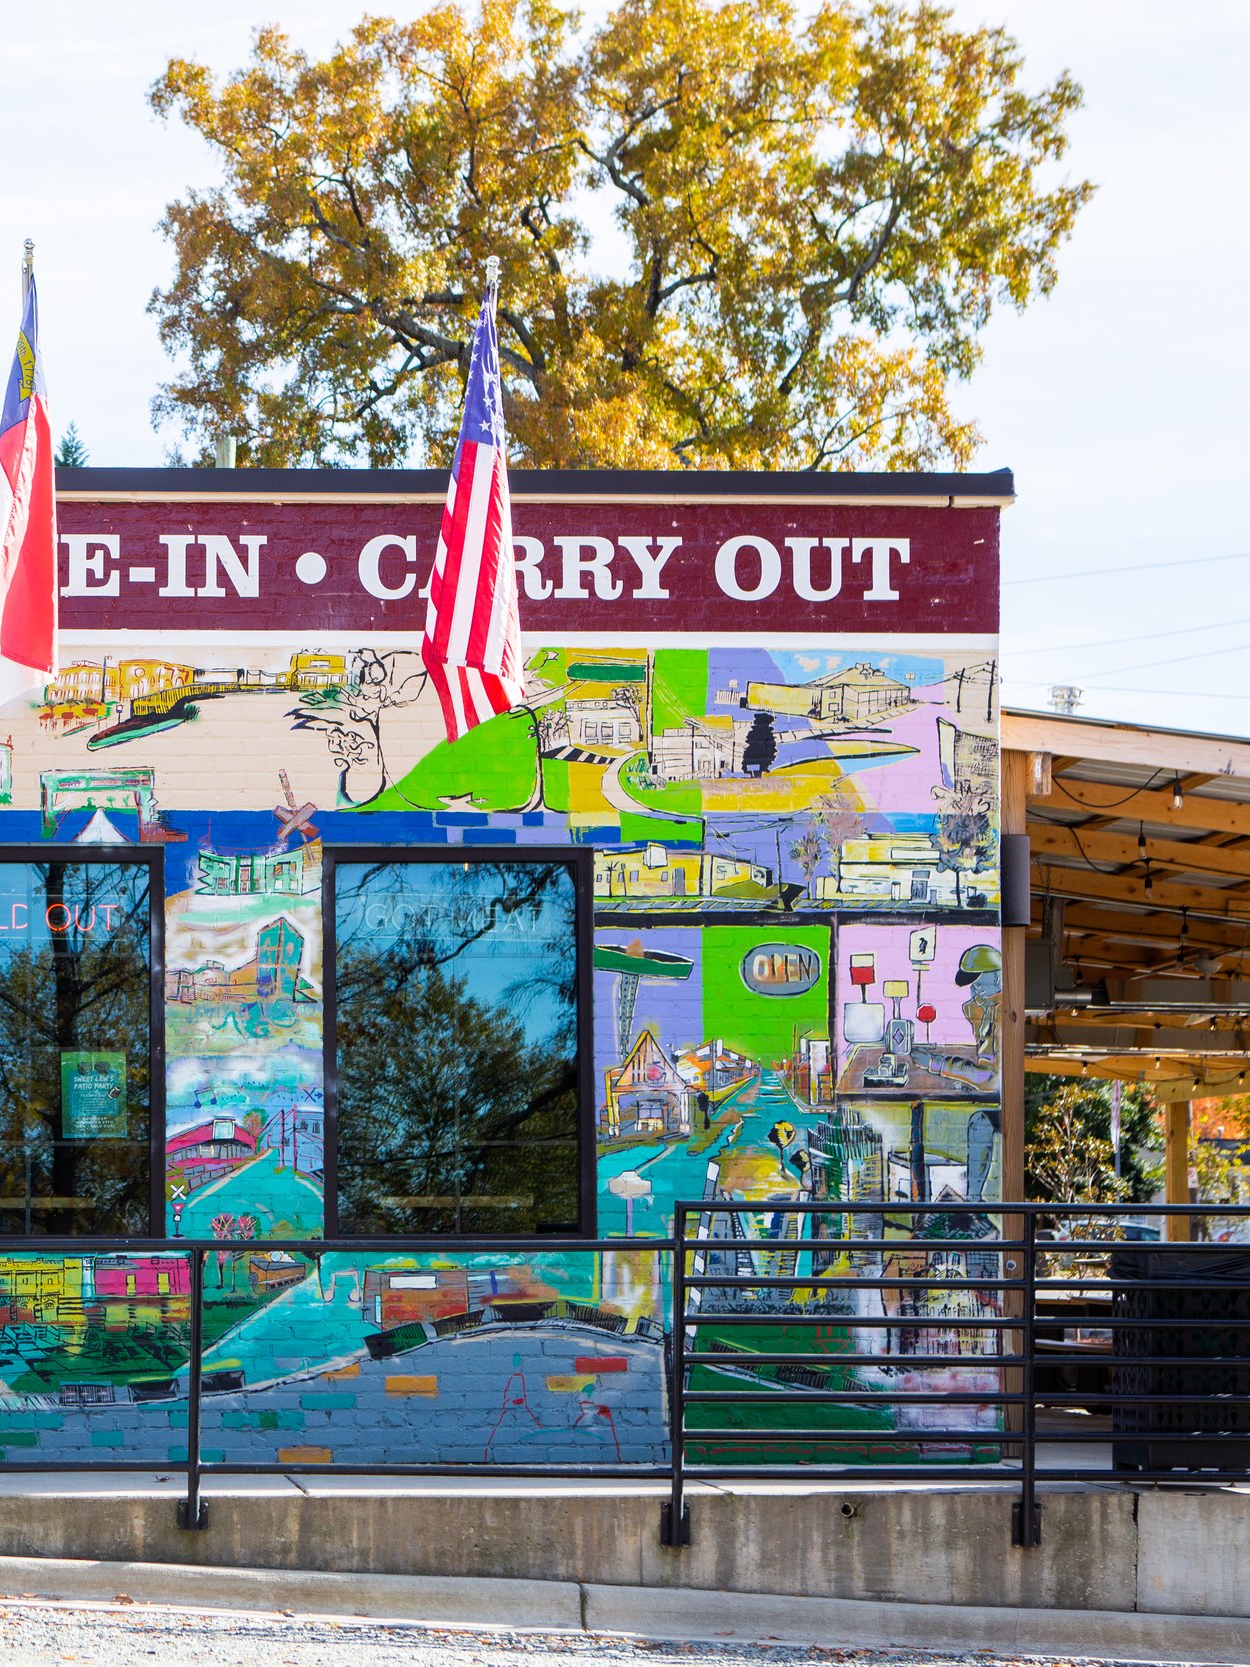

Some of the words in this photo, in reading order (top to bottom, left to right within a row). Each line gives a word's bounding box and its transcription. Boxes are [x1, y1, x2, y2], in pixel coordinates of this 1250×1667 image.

[357, 533, 683, 600] CRRY
[714, 534, 911, 602] OUT
[45, 903, 119, 932] OUT
[365, 904, 439, 931] GOT
[752, 952, 813, 983] OPEN
